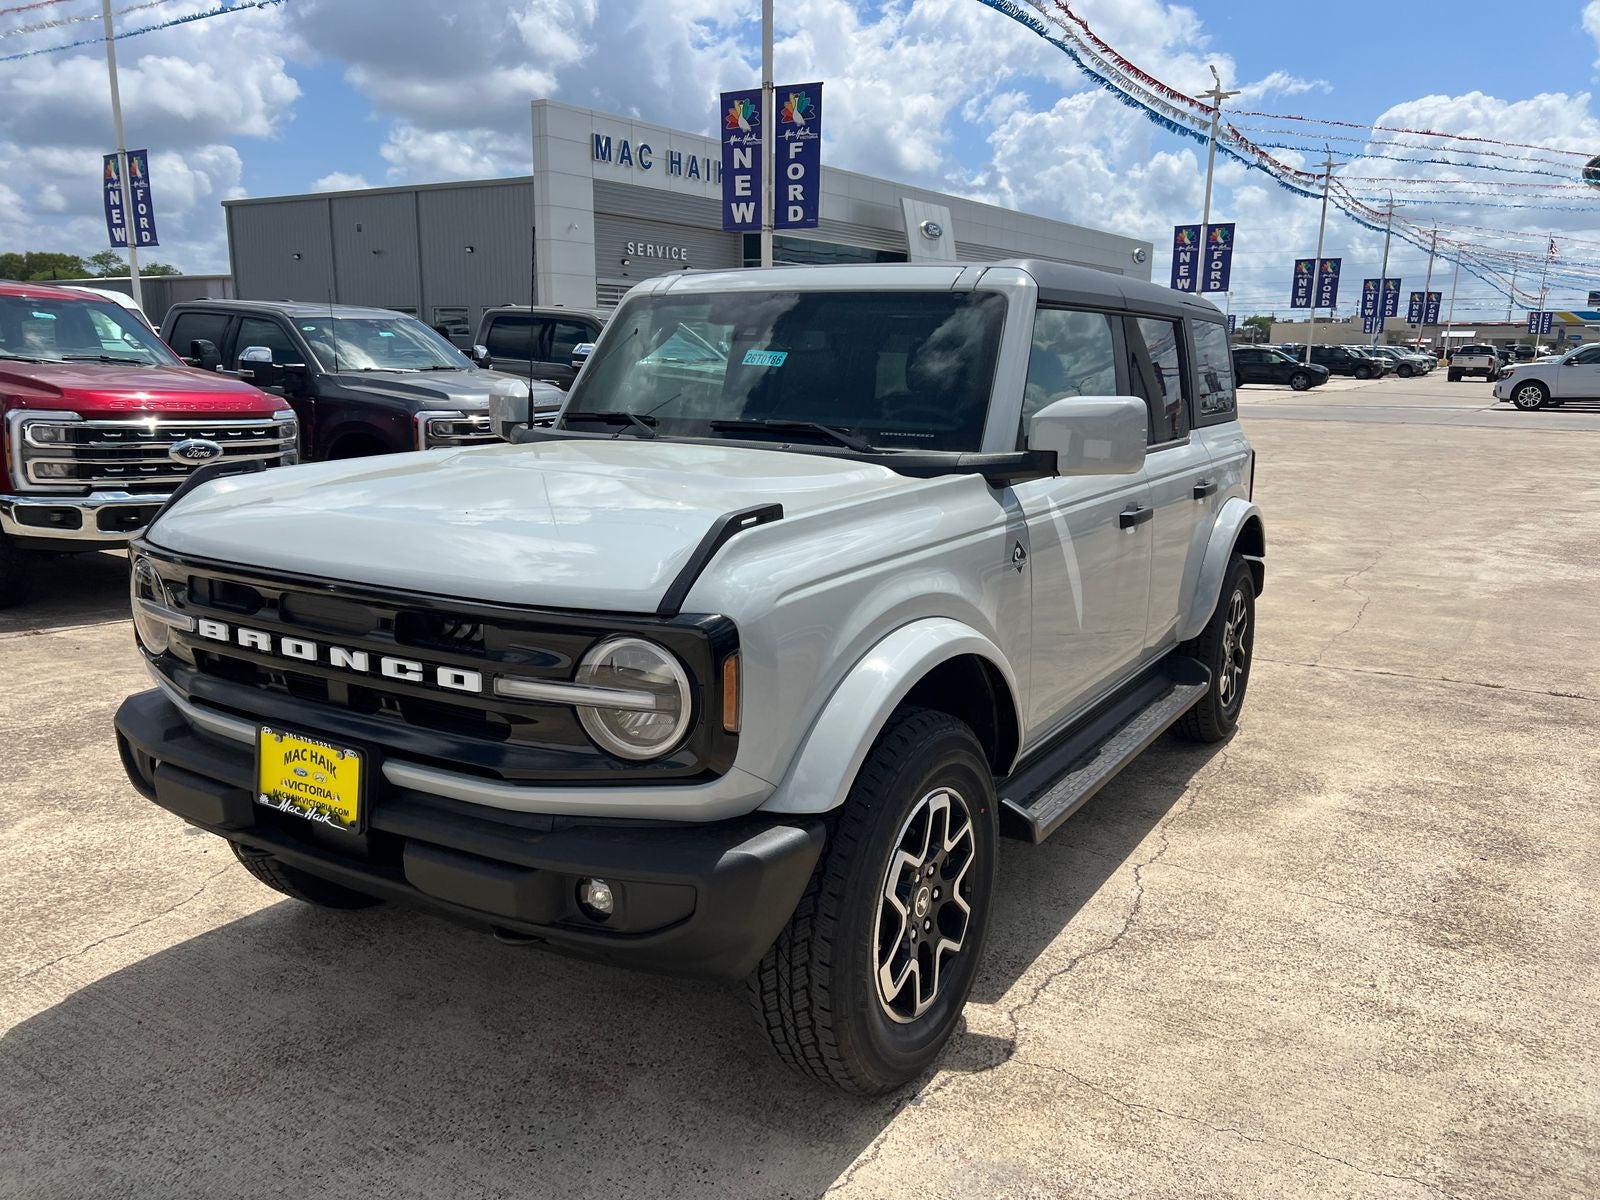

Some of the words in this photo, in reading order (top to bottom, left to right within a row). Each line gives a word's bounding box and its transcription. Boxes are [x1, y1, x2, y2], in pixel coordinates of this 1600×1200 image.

[593, 133, 653, 170] MAC
[731, 147, 755, 223] NEW
[787, 142, 805, 222] FORD
[109, 190, 126, 242] NEW
[137, 189, 151, 243] FORD
[627, 241, 687, 260] SERVICE
[1177, 252, 1191, 289] NEW
[1210, 251, 1222, 289] FORD
[1296, 279, 1307, 306] NEW
[1322, 278, 1331, 306] FORD
[1364, 294, 1374, 316] NEW
[1385, 294, 1394, 316] FORD
[1410, 304, 1419, 322] NEW
[1427, 304, 1436, 323] FORD
[187, 445, 212, 458] Ford
[199, 618, 483, 693] BRONCO
[283, 748, 308, 766] MAC
[309, 750, 337, 779] HAIK
[288, 779, 333, 800] VICTORIA
[277, 798, 304, 817] Mac
[304, 807, 336, 823] Haik
